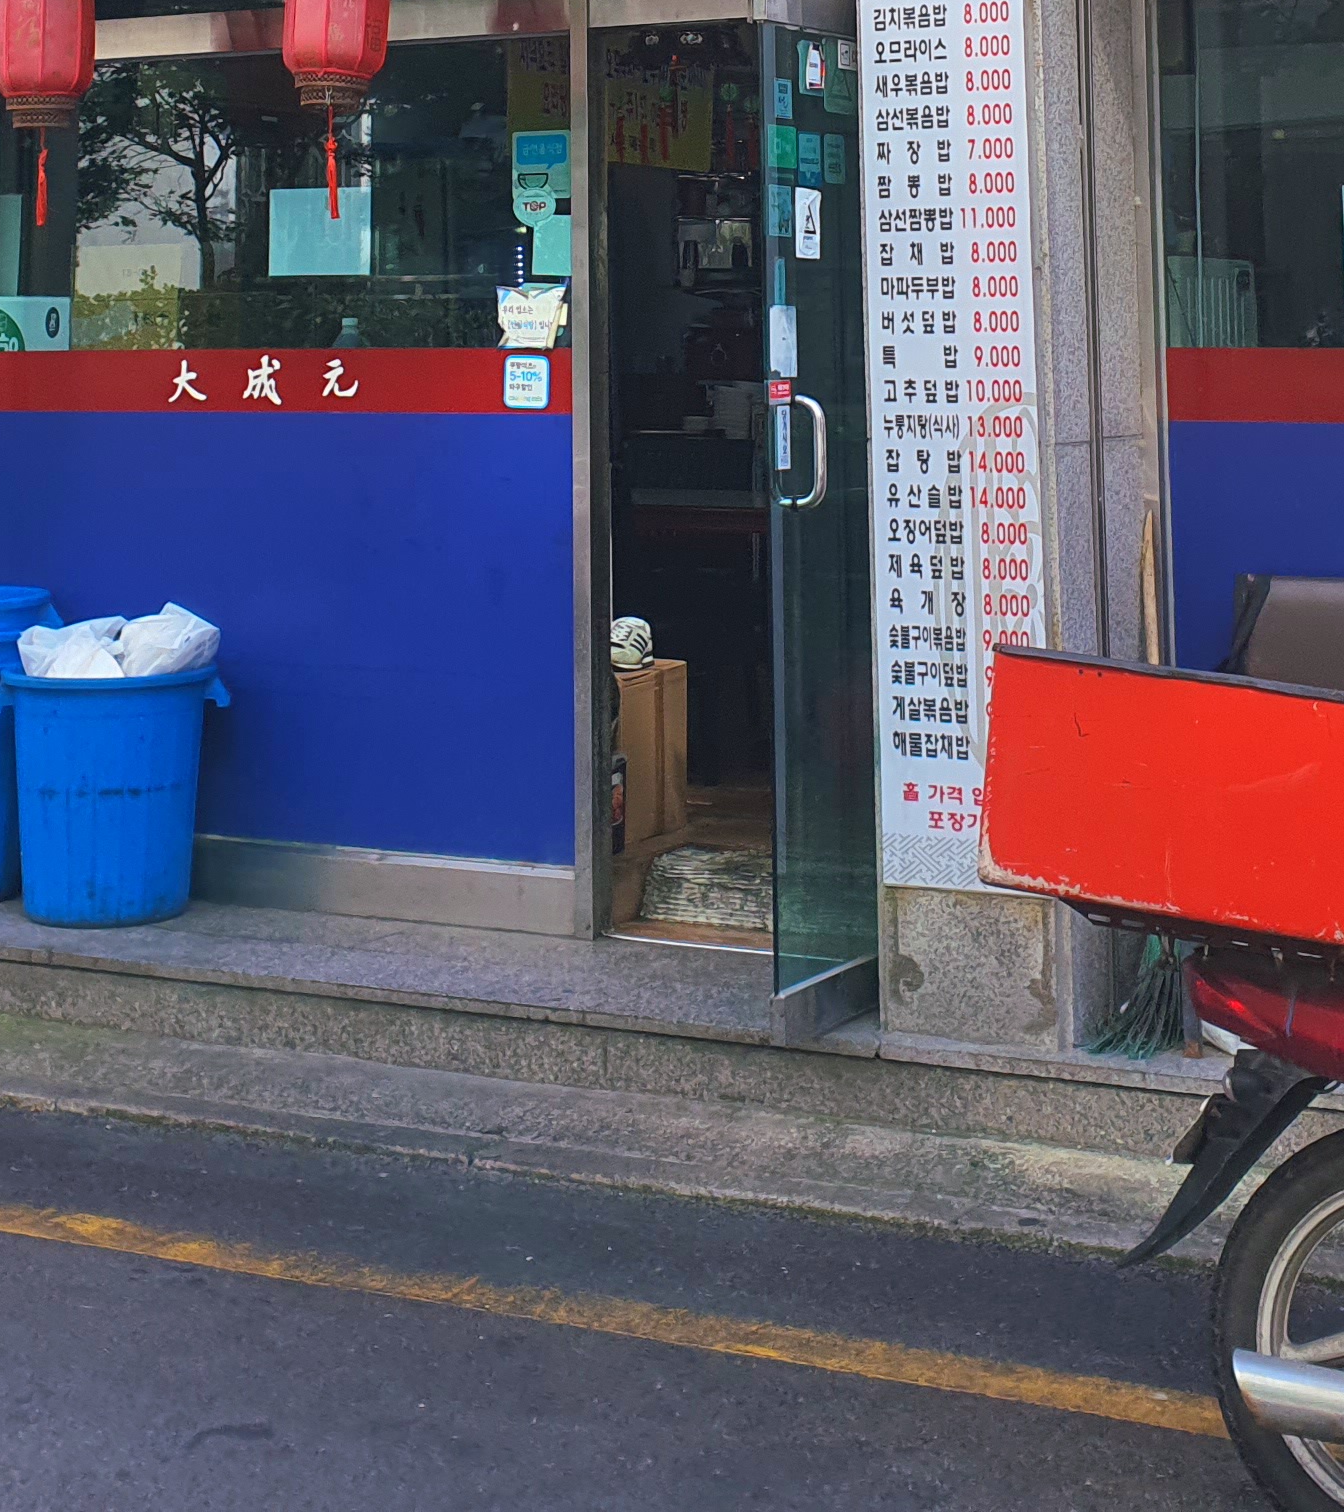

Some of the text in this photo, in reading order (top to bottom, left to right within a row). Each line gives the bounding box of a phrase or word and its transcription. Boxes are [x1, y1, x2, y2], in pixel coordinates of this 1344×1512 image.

[873, 0, 1010, 31] 김치볶음밥 8.000
[874, 34, 1011, 64] 오므라이스 8.000
[874, 68, 1012, 98] 새우볶음밥 8.000
[875, 102, 1013, 131] 삼선볶음밥 8.000
[876, 137, 1014, 165] 짜장밥 7.000
[877, 171, 1015, 199] 짬뽕밥 8.000
[878, 206, 1016, 233] 삼선짬뽕밥 11.000
[879, 240, 1017, 266] 잡채밥 8.000
[880, 275, 1019, 300] 마파두부밥 8.000
[881, 310, 1020, 335] 버섯덮밥 8.000
[974, 345, 1021, 368] 9.000
[509, 371, 543, 382] 5-10%
[883, 378, 1023, 404] 고추덮밥 10.000
[883, 413, 1024, 441] 누룽지탕(식사) 13.000
[885, 448, 1025, 474] 잡탕밥 14.000
[886, 482, 1026, 509] 유산슬밥 14.000
[887, 517, 1028, 545] 오징어덮밥 8.000
[888, 553, 1029, 581] 제육덮밥 8.000
[889, 587, 1030, 617] 육개장 8.000
[889, 623, 966, 652] 숯불구이볶음밥
[890, 660, 968, 688] 숯불구이덮밥
[891, 695, 969, 724] 게살볶음밥
[893, 730, 971, 760] 해물잡채밥
[903, 782, 920, 802] 홀
[928, 785, 964, 805] 가격
